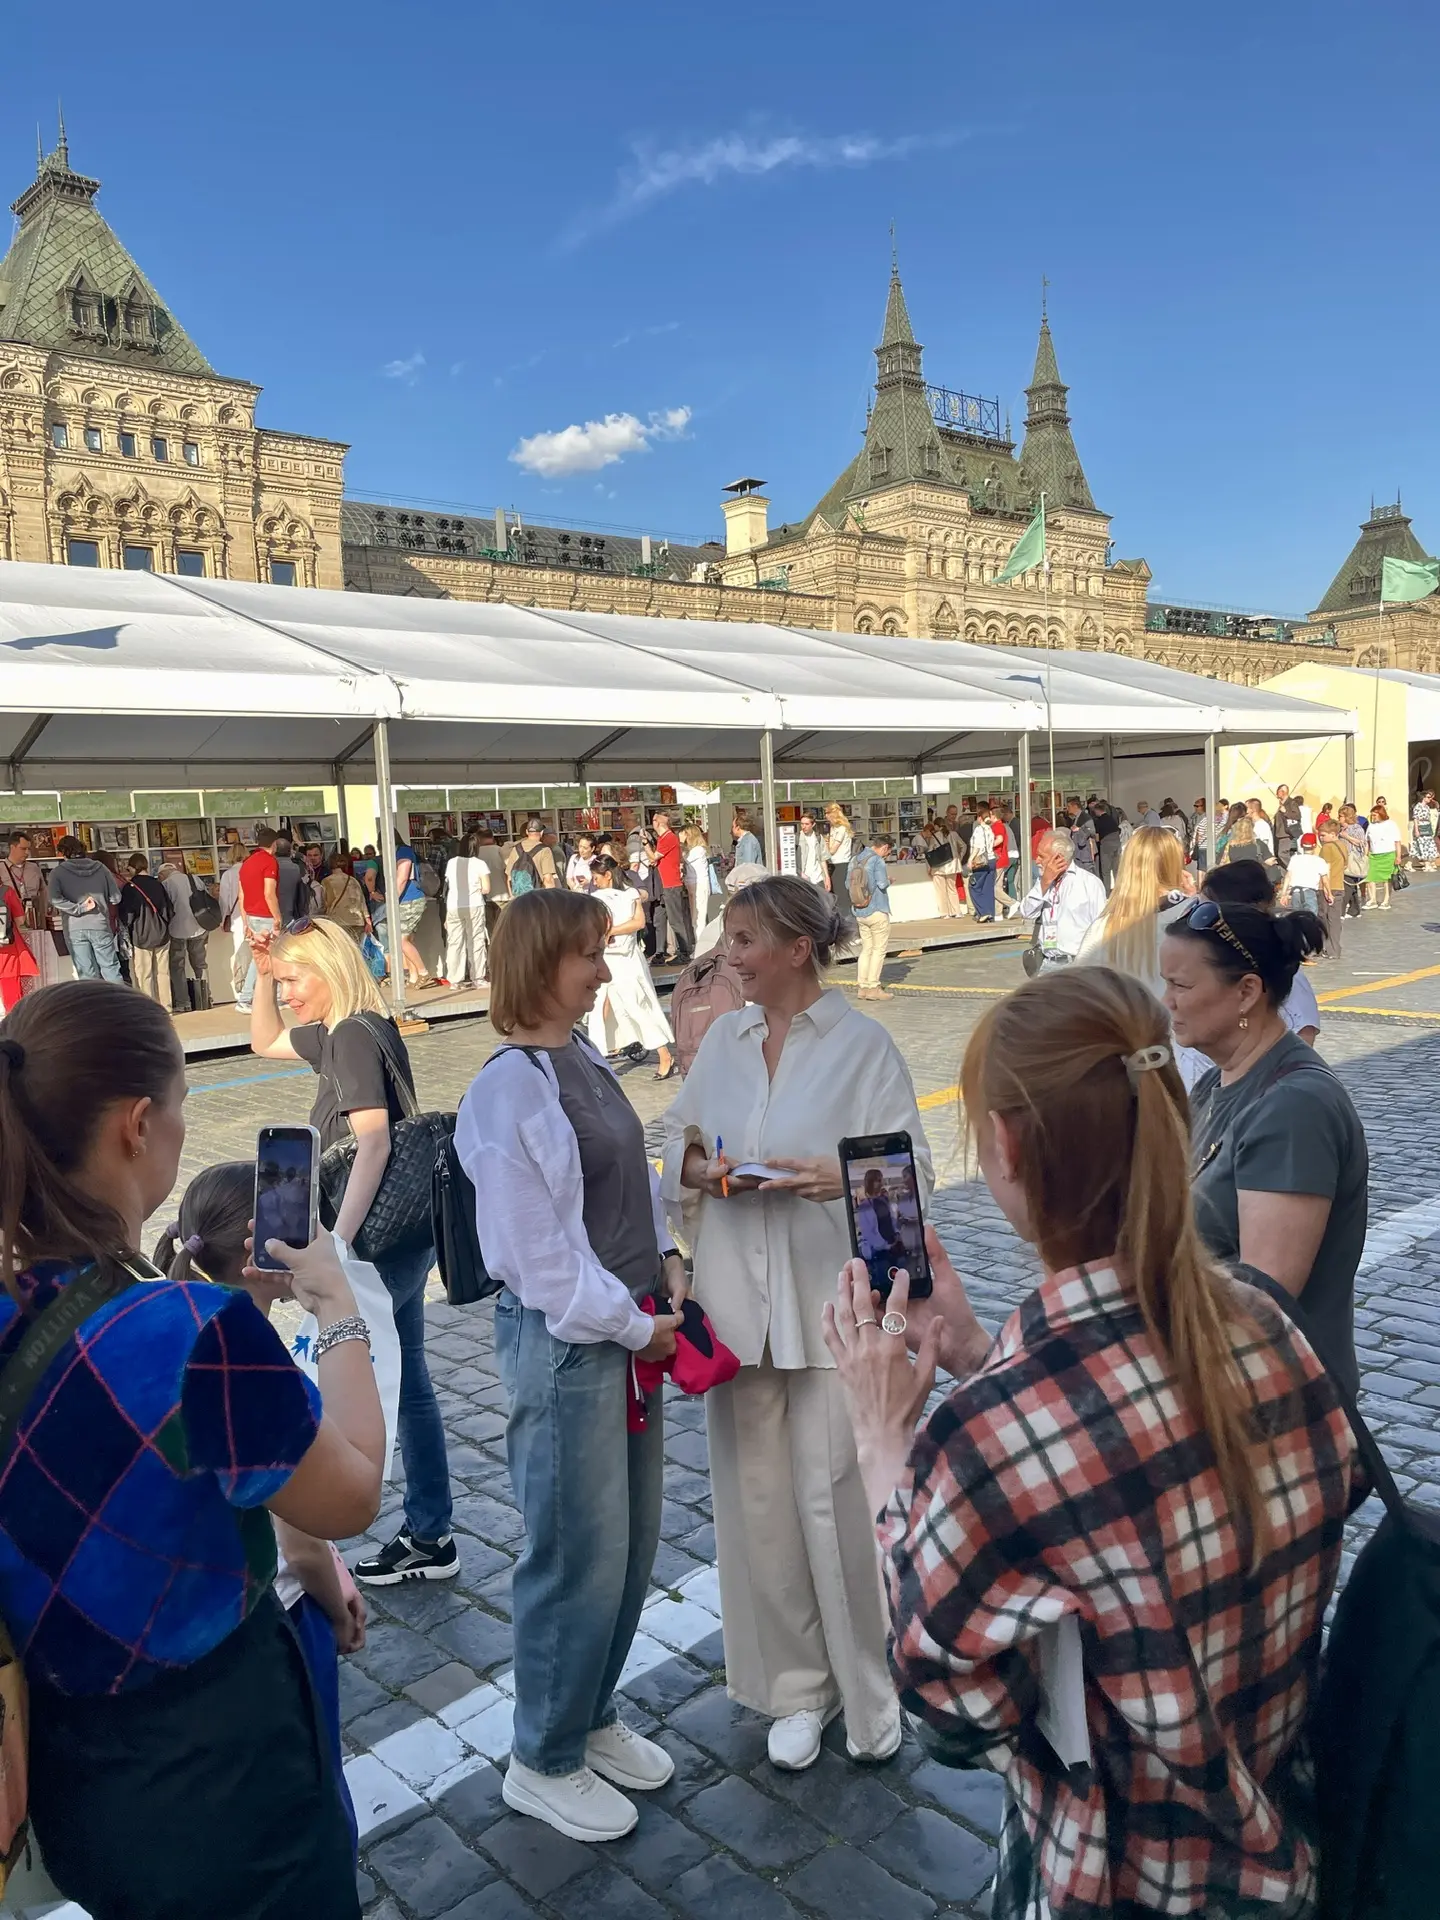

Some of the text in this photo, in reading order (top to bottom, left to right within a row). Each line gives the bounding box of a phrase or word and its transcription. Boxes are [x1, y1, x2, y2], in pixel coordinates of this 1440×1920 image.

[932, 392, 979, 421] ГУМ
[149, 802, 188, 811] ЭТЕРНА
[22, 1291, 92, 1369] VUITTON
